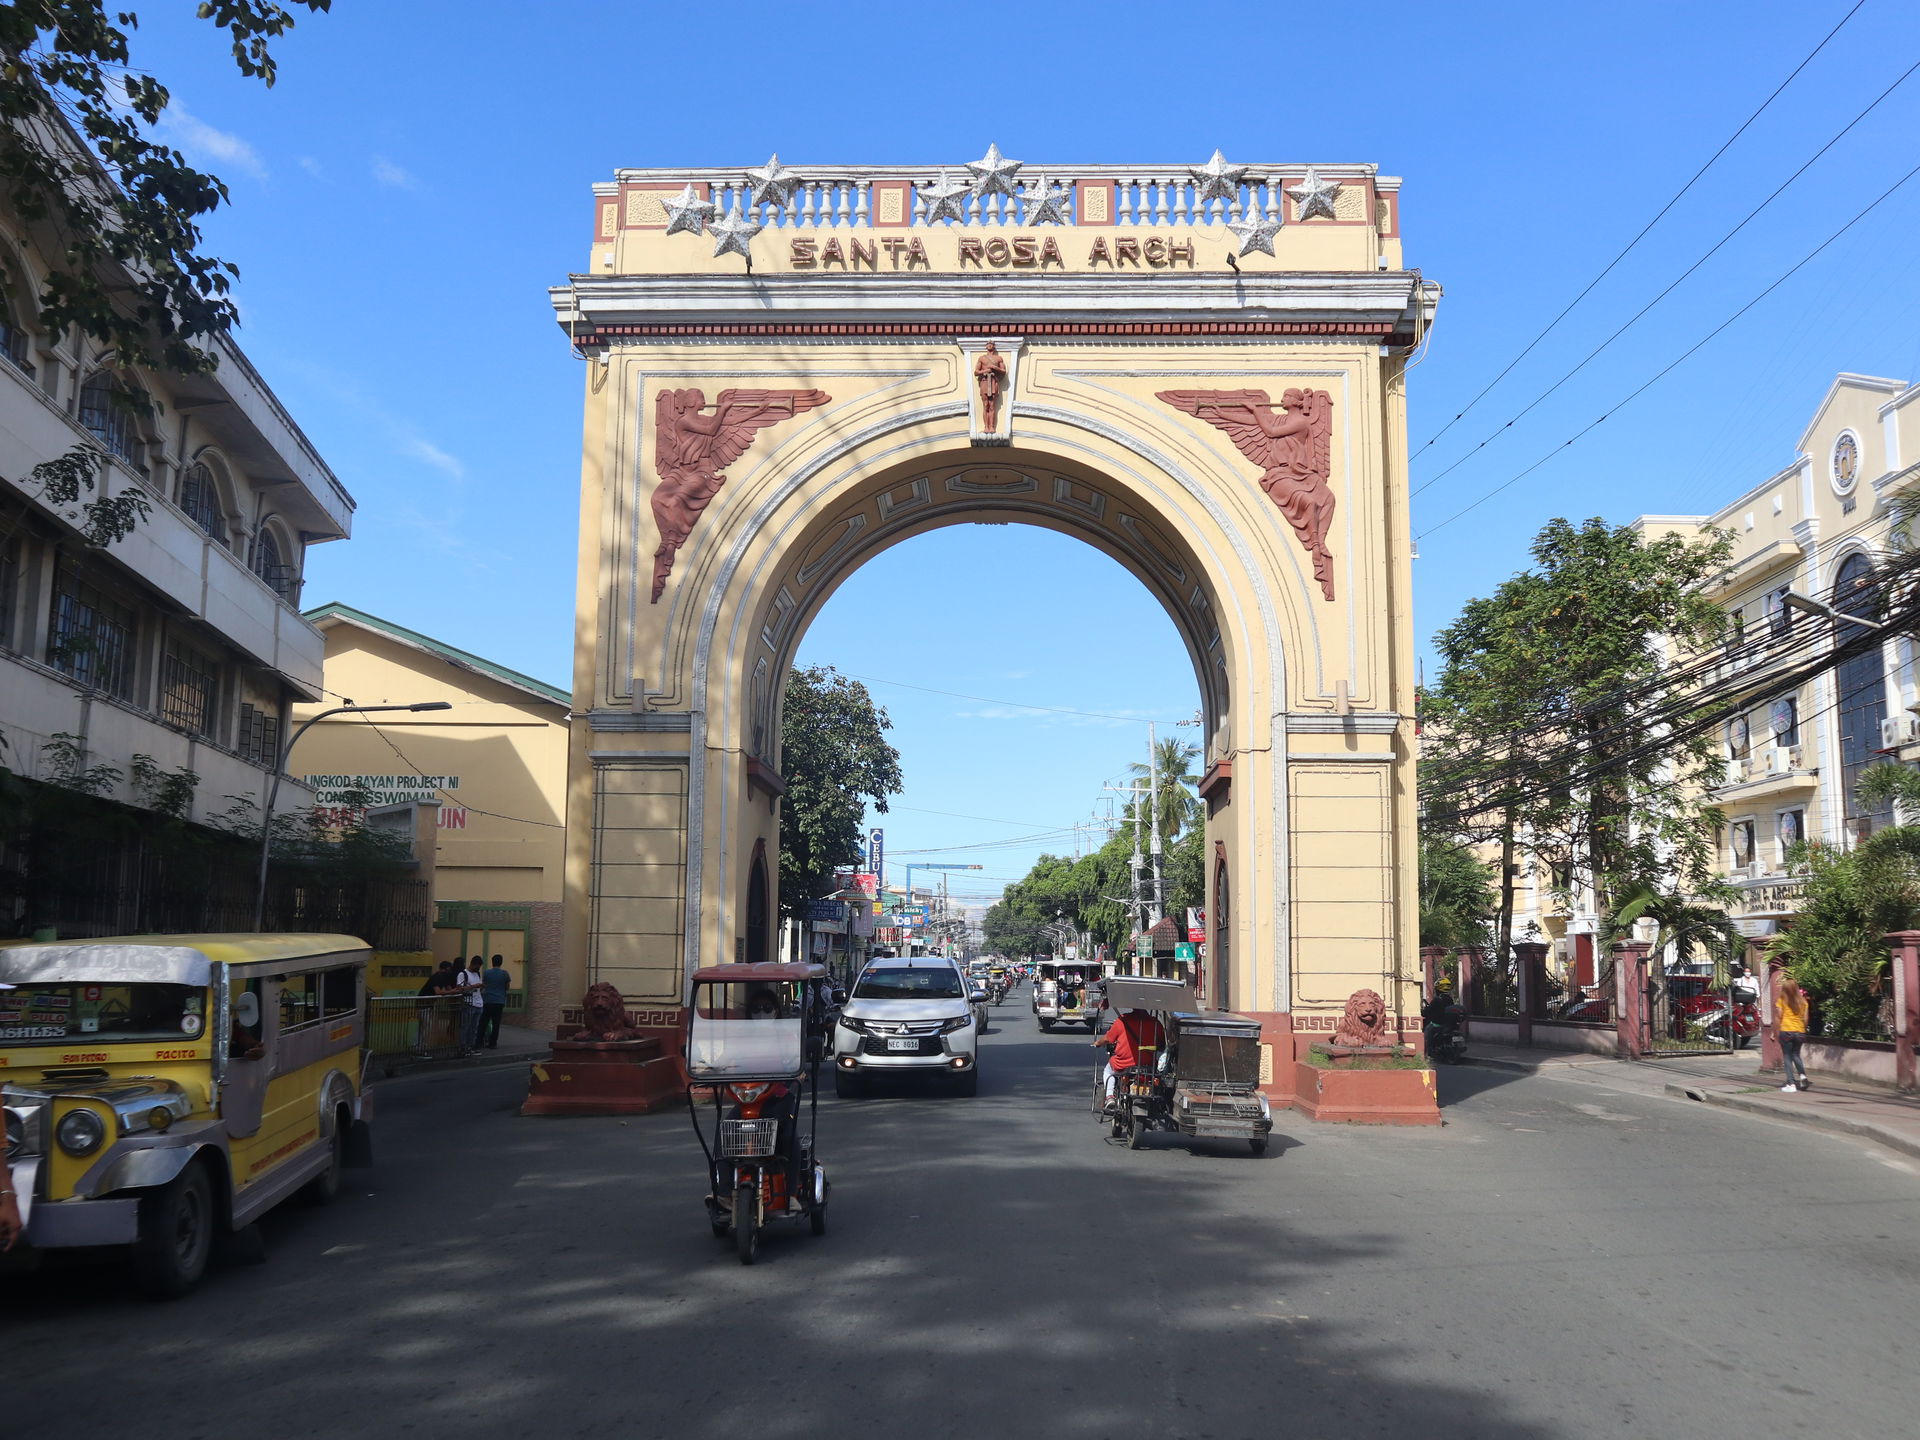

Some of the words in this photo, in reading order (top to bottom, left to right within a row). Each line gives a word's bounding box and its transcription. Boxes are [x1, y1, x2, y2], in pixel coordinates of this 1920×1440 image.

[790, 236, 928, 268] SANTA
[958, 236, 1062, 268] ROSA
[1089, 236, 1194, 266] ARCH
[304, 775, 350, 788] LINGKOD
[356, 775, 394, 788] BAYAN
[397, 776, 445, 788] PROJECT
[448, 776, 459, 788] NI
[316, 791, 435, 804] CONGSSWOMAN
[870, 831, 882, 894] CEBUAN
